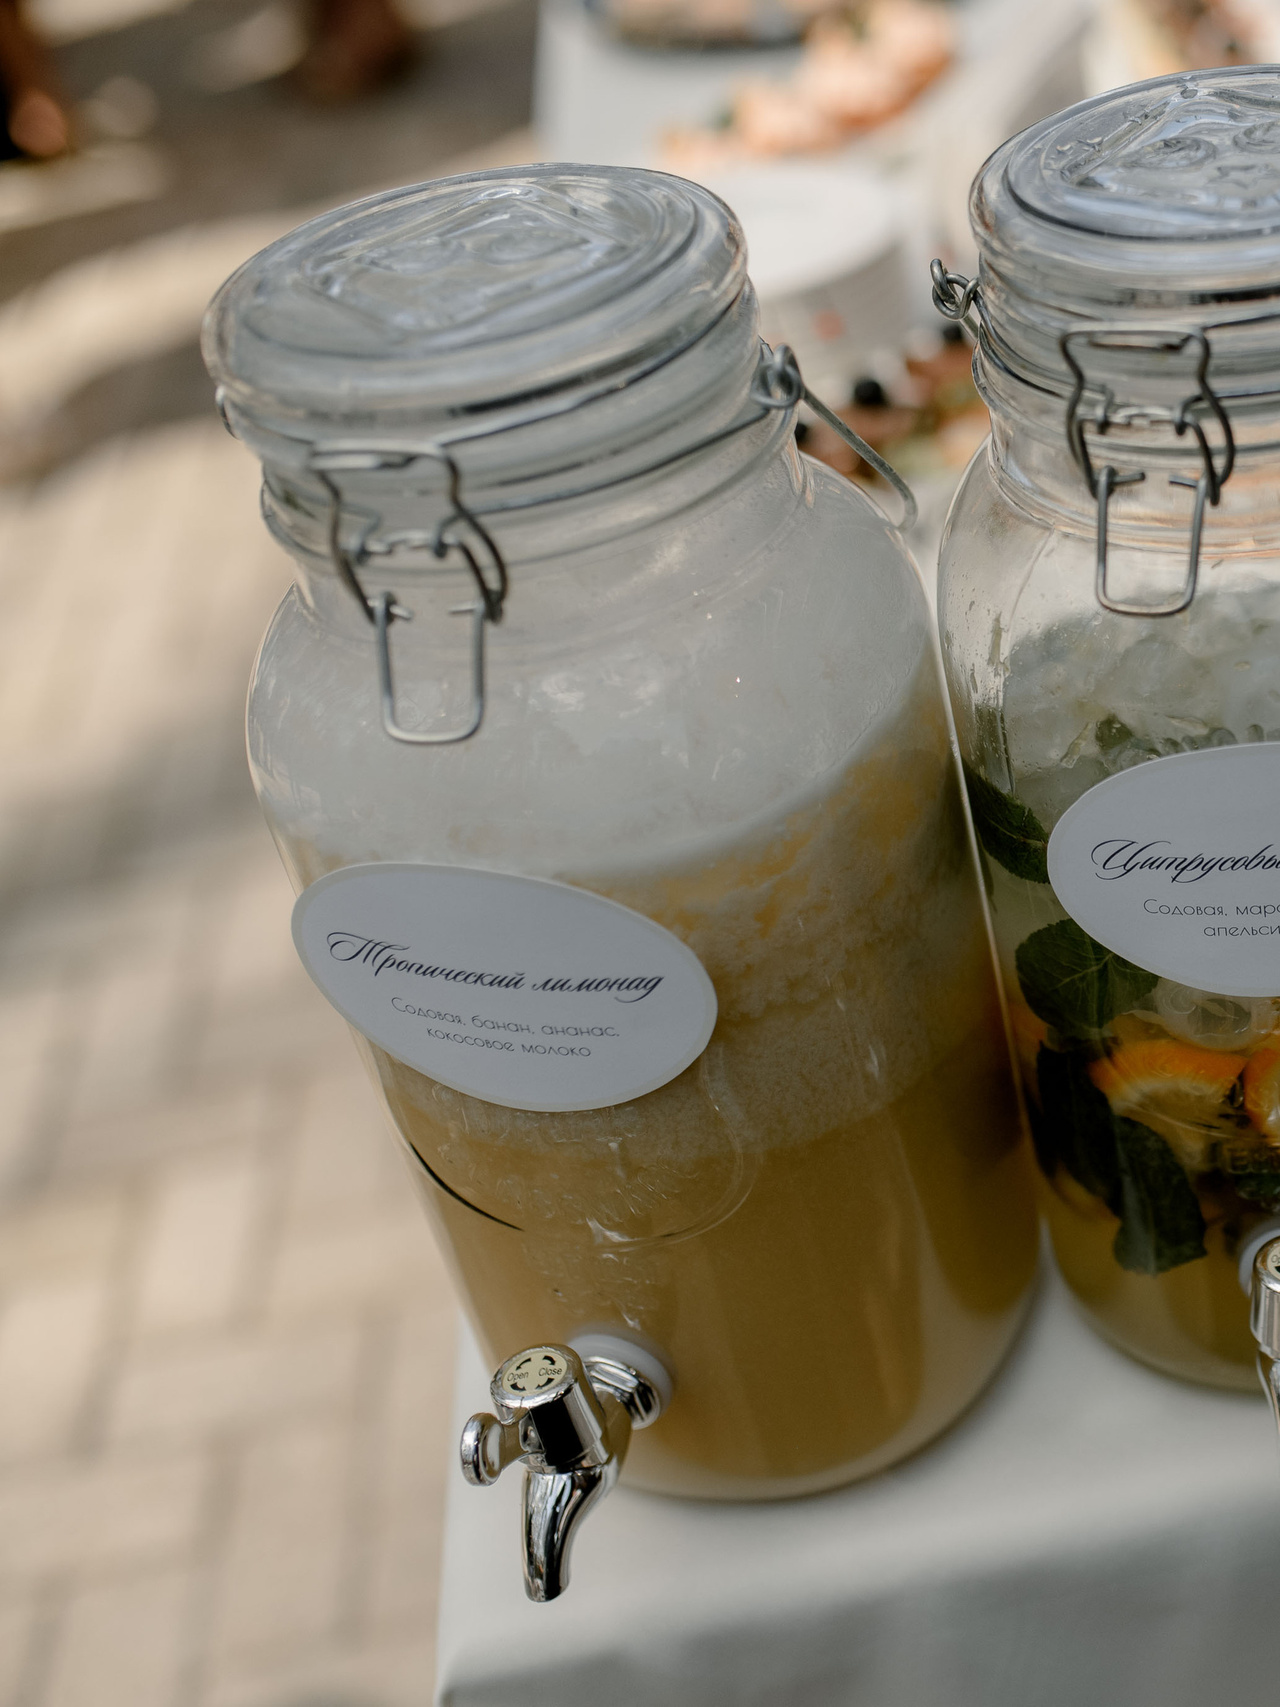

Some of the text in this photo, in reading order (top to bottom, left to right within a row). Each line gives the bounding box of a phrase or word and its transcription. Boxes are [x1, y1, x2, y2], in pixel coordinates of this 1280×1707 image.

[326, 931, 665, 1004] Тропический лимонад
[426, 1027, 592, 1058] кокосовое молоко
[507, 1366, 563, 1382] Open Close
